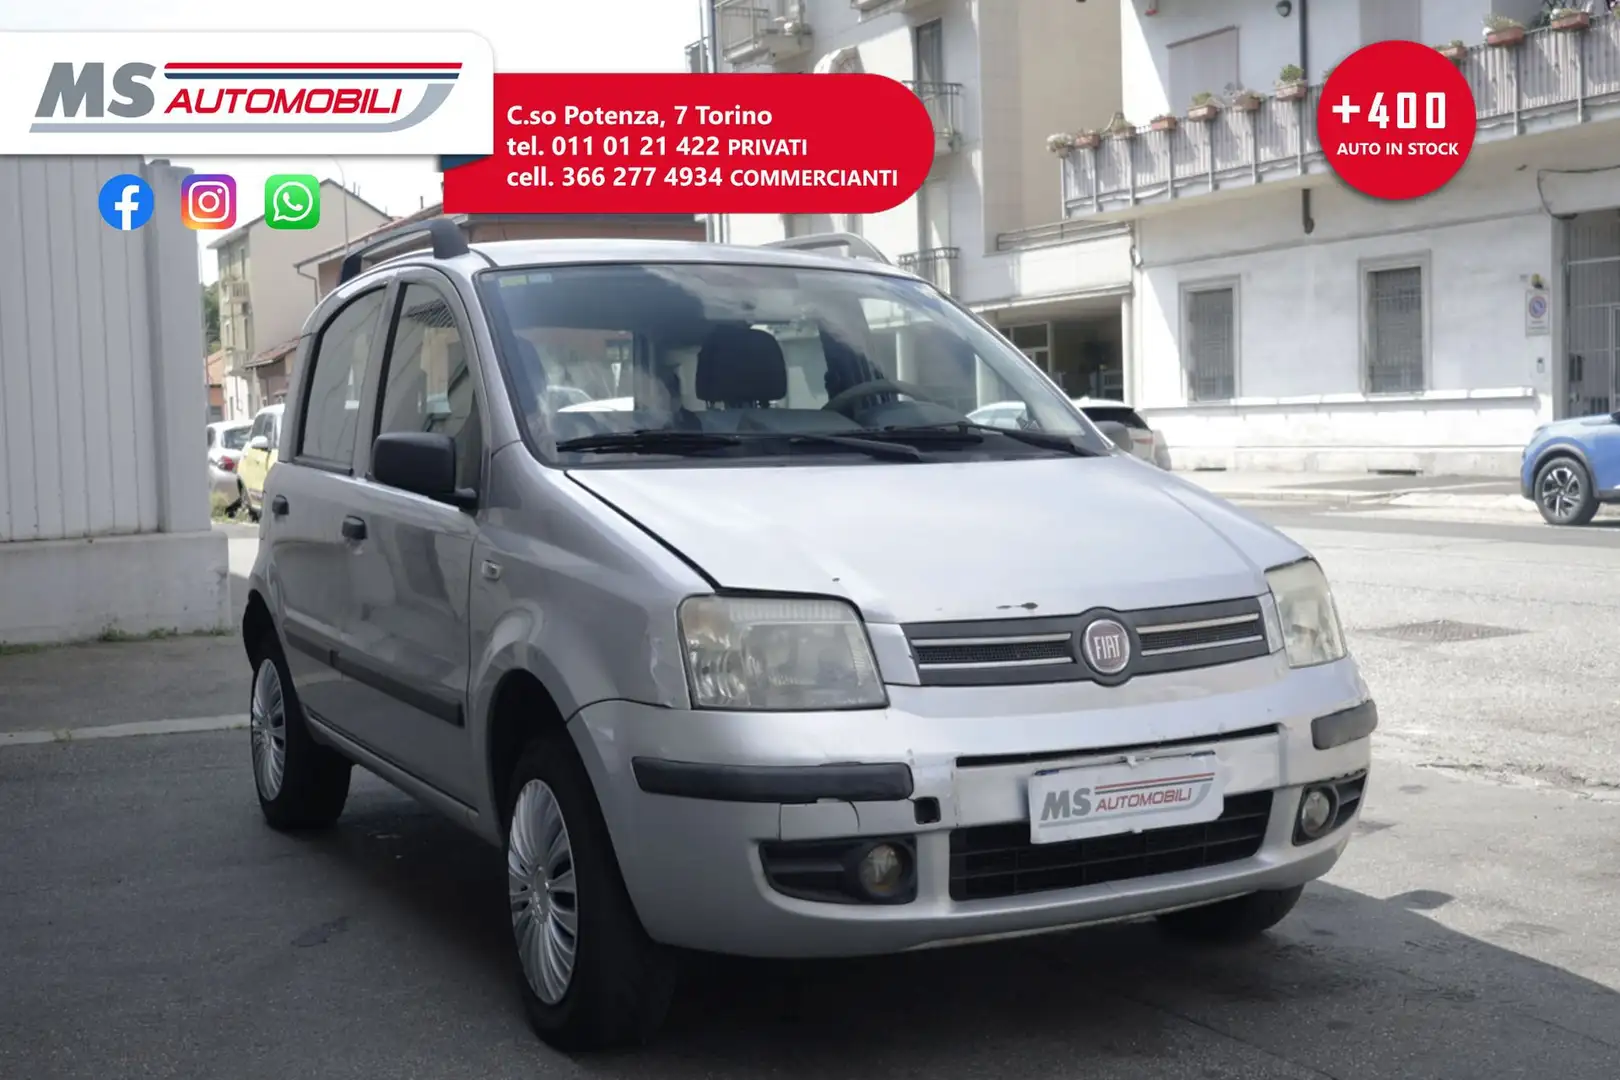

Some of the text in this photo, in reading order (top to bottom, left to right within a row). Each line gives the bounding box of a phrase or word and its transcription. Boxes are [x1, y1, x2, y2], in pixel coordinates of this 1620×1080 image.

[1093, 634, 1120, 660] FIAT
[1040, 787, 1193, 821] MS AUTOMOBILI
